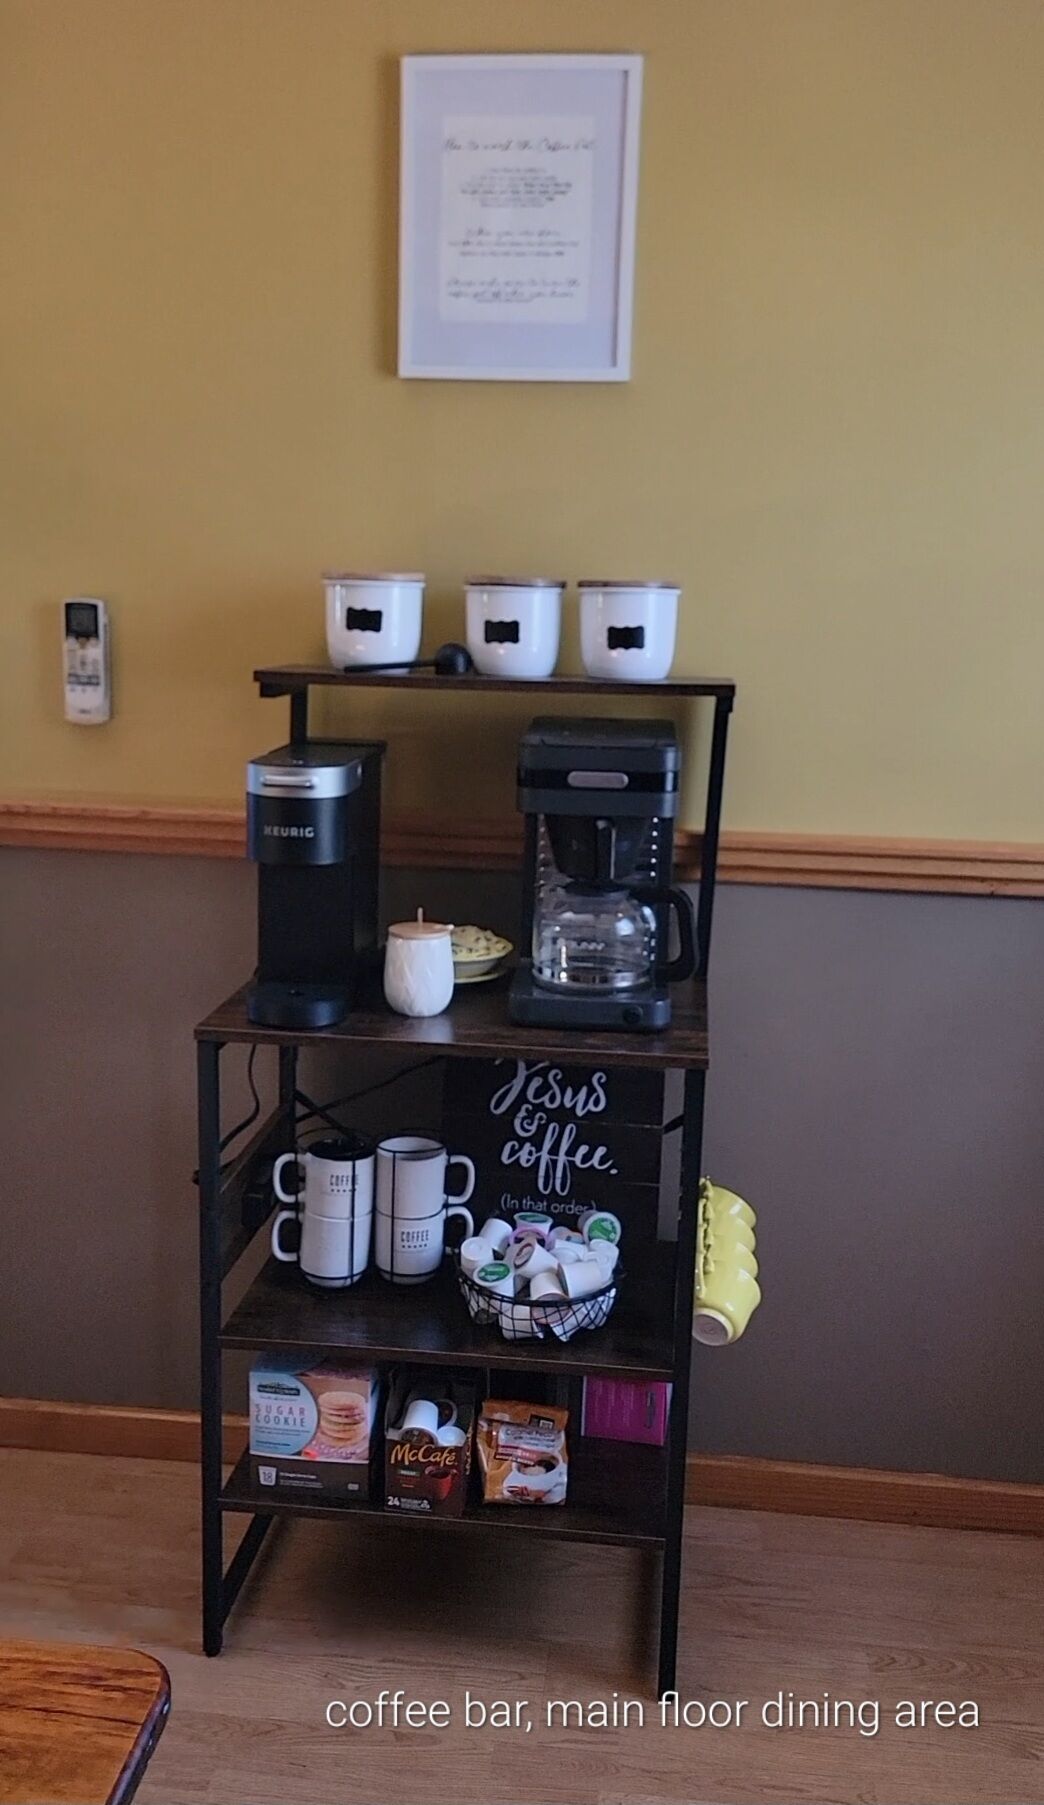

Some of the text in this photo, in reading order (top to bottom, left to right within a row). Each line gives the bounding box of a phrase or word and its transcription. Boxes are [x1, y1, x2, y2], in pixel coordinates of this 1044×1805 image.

[263, 825, 315, 838] KEURIG
[490, 1057, 607, 1117] Jesus
[513, 1103, 547, 1137] &
[501, 1193, 519, 1211] (In
[522, 1195, 547, 1212] that
[400, 1229, 430, 1243] COFFEE
[255, 1403, 306, 1416] SUGAR
[255, 1413, 306, 1428] COOKIE
[390, 1443, 456, 1467] McCafé
[387, 1495, 400, 1507] 24
